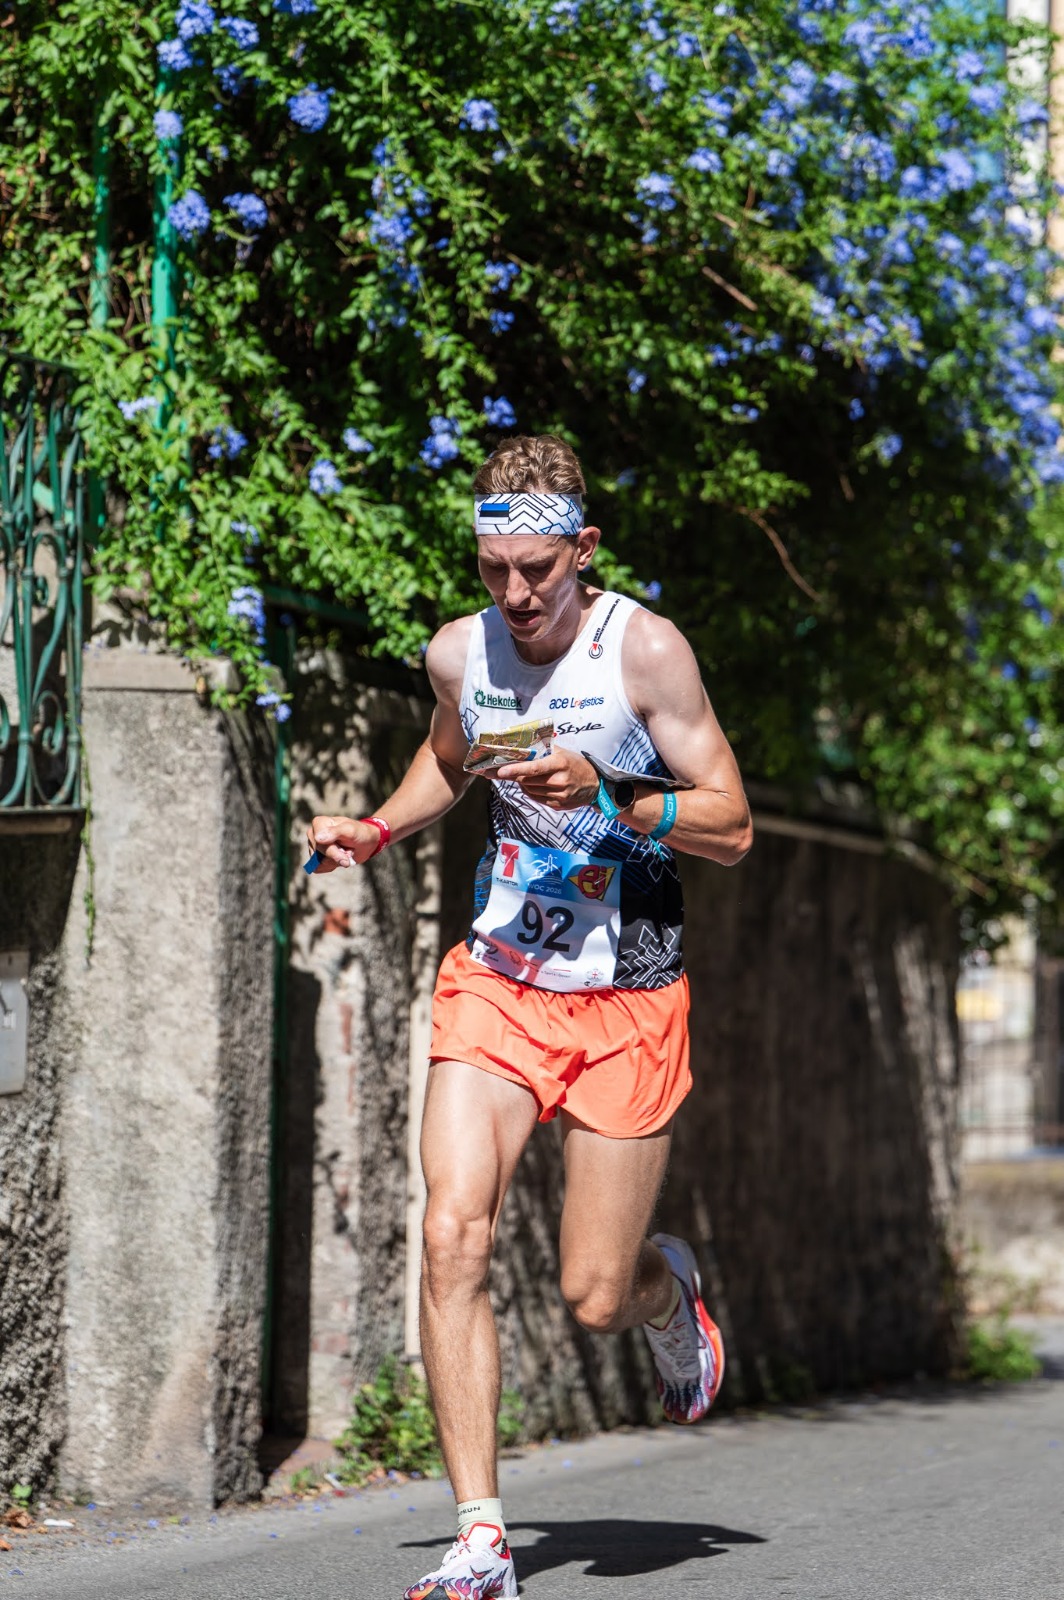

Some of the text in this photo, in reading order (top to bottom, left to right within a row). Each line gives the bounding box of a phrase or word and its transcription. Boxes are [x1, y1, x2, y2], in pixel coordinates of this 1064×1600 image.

[487, 694, 522, 708] Hekotek
[549, 696, 605, 710] ace Logistics
[556, 721, 605, 736] Style
[517, 900, 575, 952] 92
